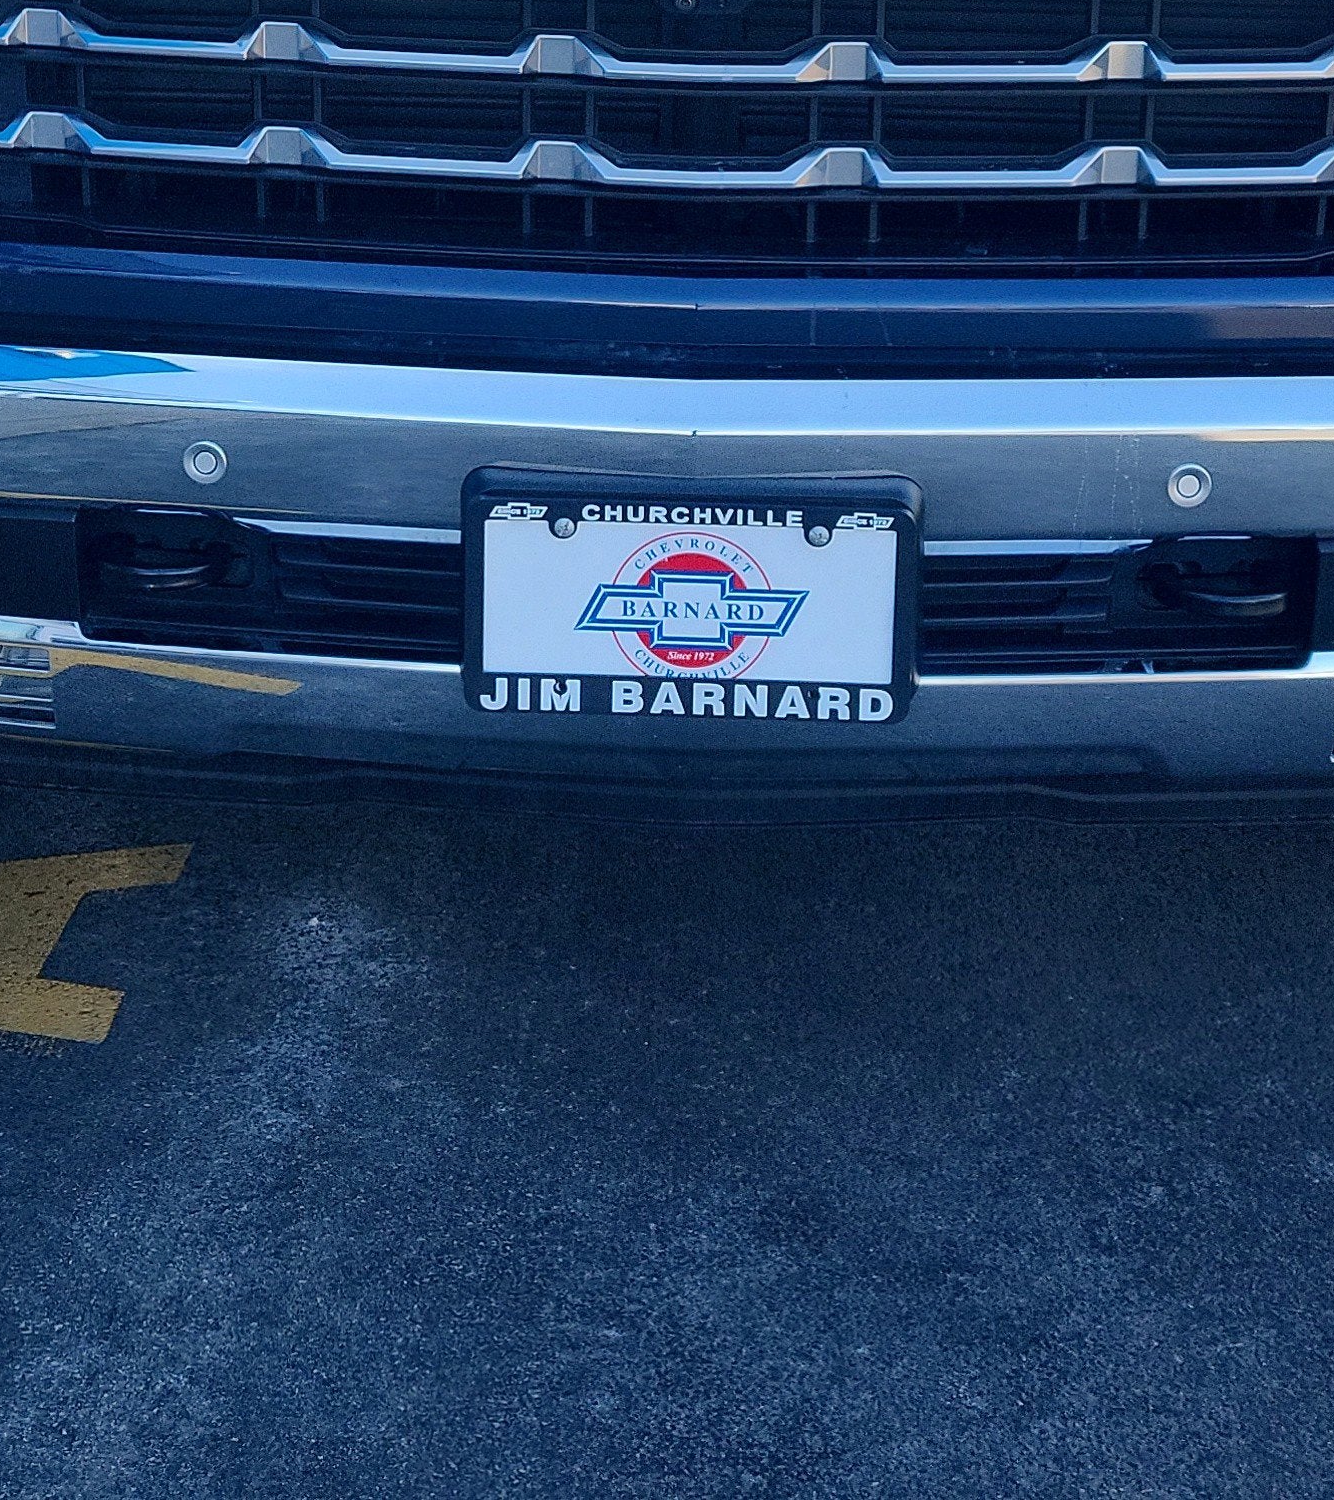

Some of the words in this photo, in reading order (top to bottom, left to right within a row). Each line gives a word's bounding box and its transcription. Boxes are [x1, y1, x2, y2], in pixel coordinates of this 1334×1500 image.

[581, 503, 804, 528] CHURCHVILLE
[634, 537, 754, 574] CHEVROLET
[621, 600, 765, 621] BARNARD
[667, 651, 693, 661] Since
[693, 651, 716, 662] 1972
[479, 677, 582, 712] JIM
[611, 680, 895, 723] BARNARD
